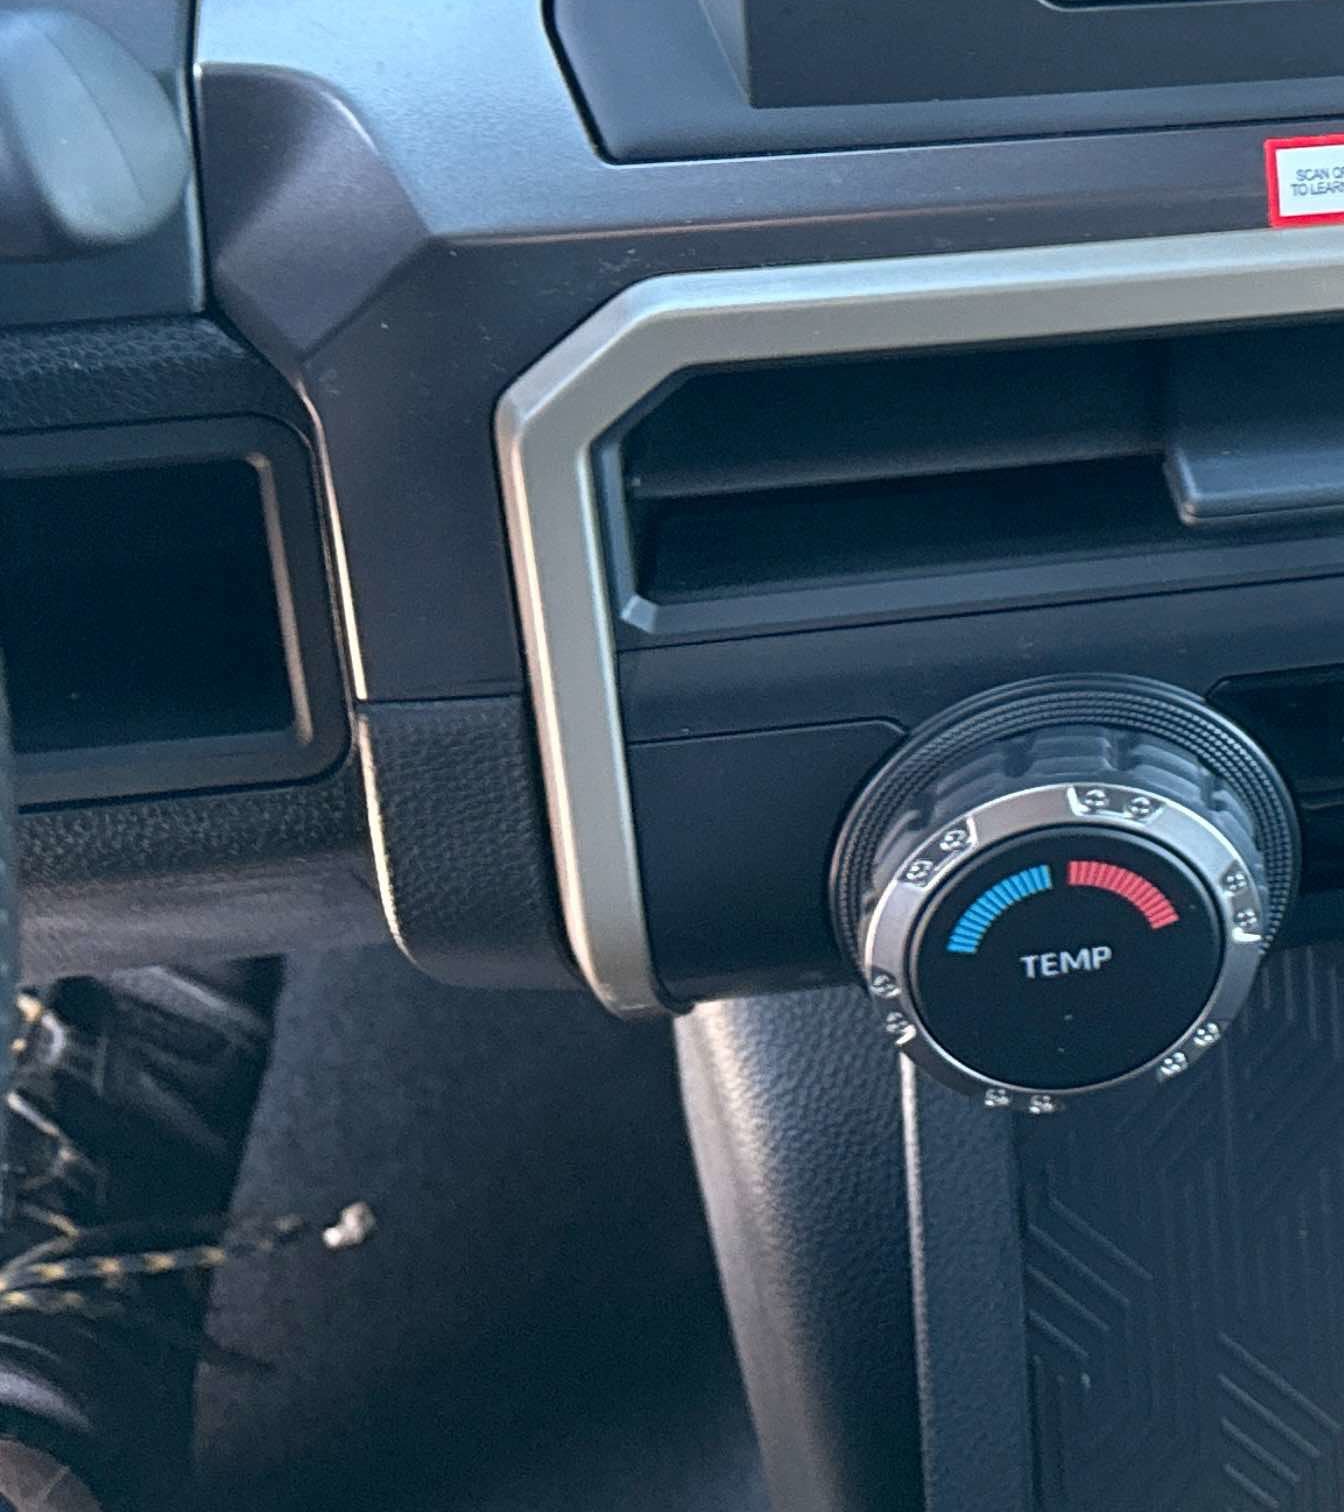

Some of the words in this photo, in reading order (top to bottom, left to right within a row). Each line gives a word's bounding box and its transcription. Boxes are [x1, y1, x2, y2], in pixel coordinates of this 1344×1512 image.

[1295, 167, 1330, 182] SCAN
[1291, 182, 1308, 197] TO
[1020, 945, 1113, 979] TEMP
